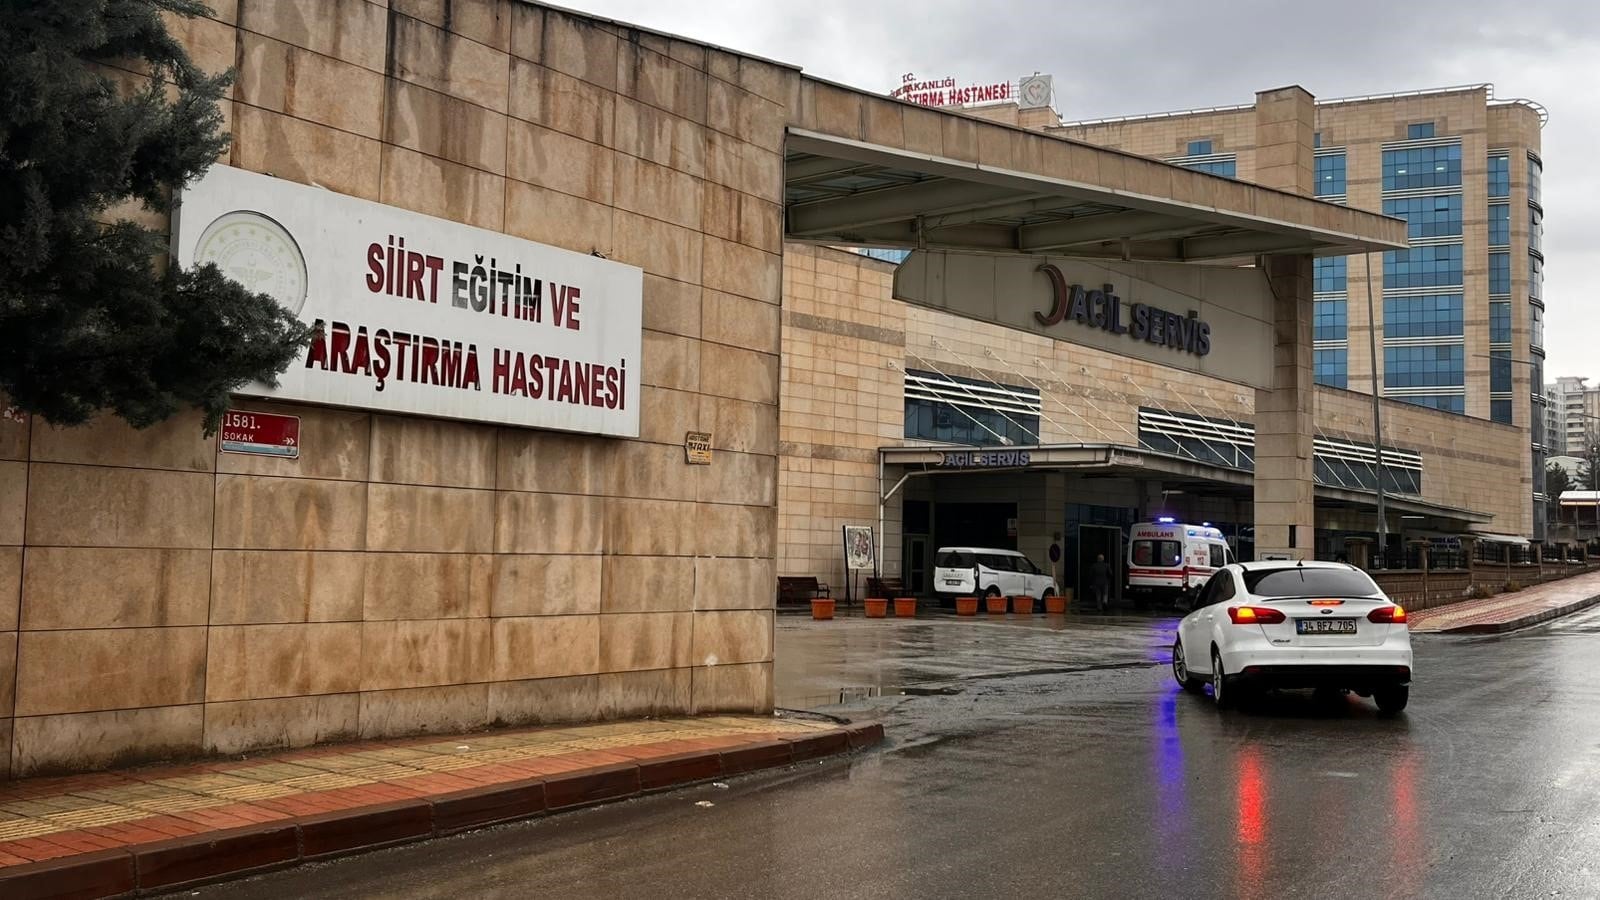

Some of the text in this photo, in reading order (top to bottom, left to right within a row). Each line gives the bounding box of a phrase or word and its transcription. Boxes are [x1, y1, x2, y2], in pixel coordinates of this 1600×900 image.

[949, 80, 1010, 104] HASTANESİ
[366, 234, 444, 304] SİİRT
[452, 254, 542, 323] EĞİTİM
[549, 282, 581, 331] VE
[1064, 283, 1211, 357] ACİL SERVİS
[305, 318, 625, 410] ARAŞTIRMA HASTANESİ
[225, 413, 261, 429] 1581.
[223, 431, 254, 442] SOKAK
[980, 450, 1030, 466] SERVİS
[1303, 621, 1314, 630] 34
[1338, 621, 1354, 630] 705
